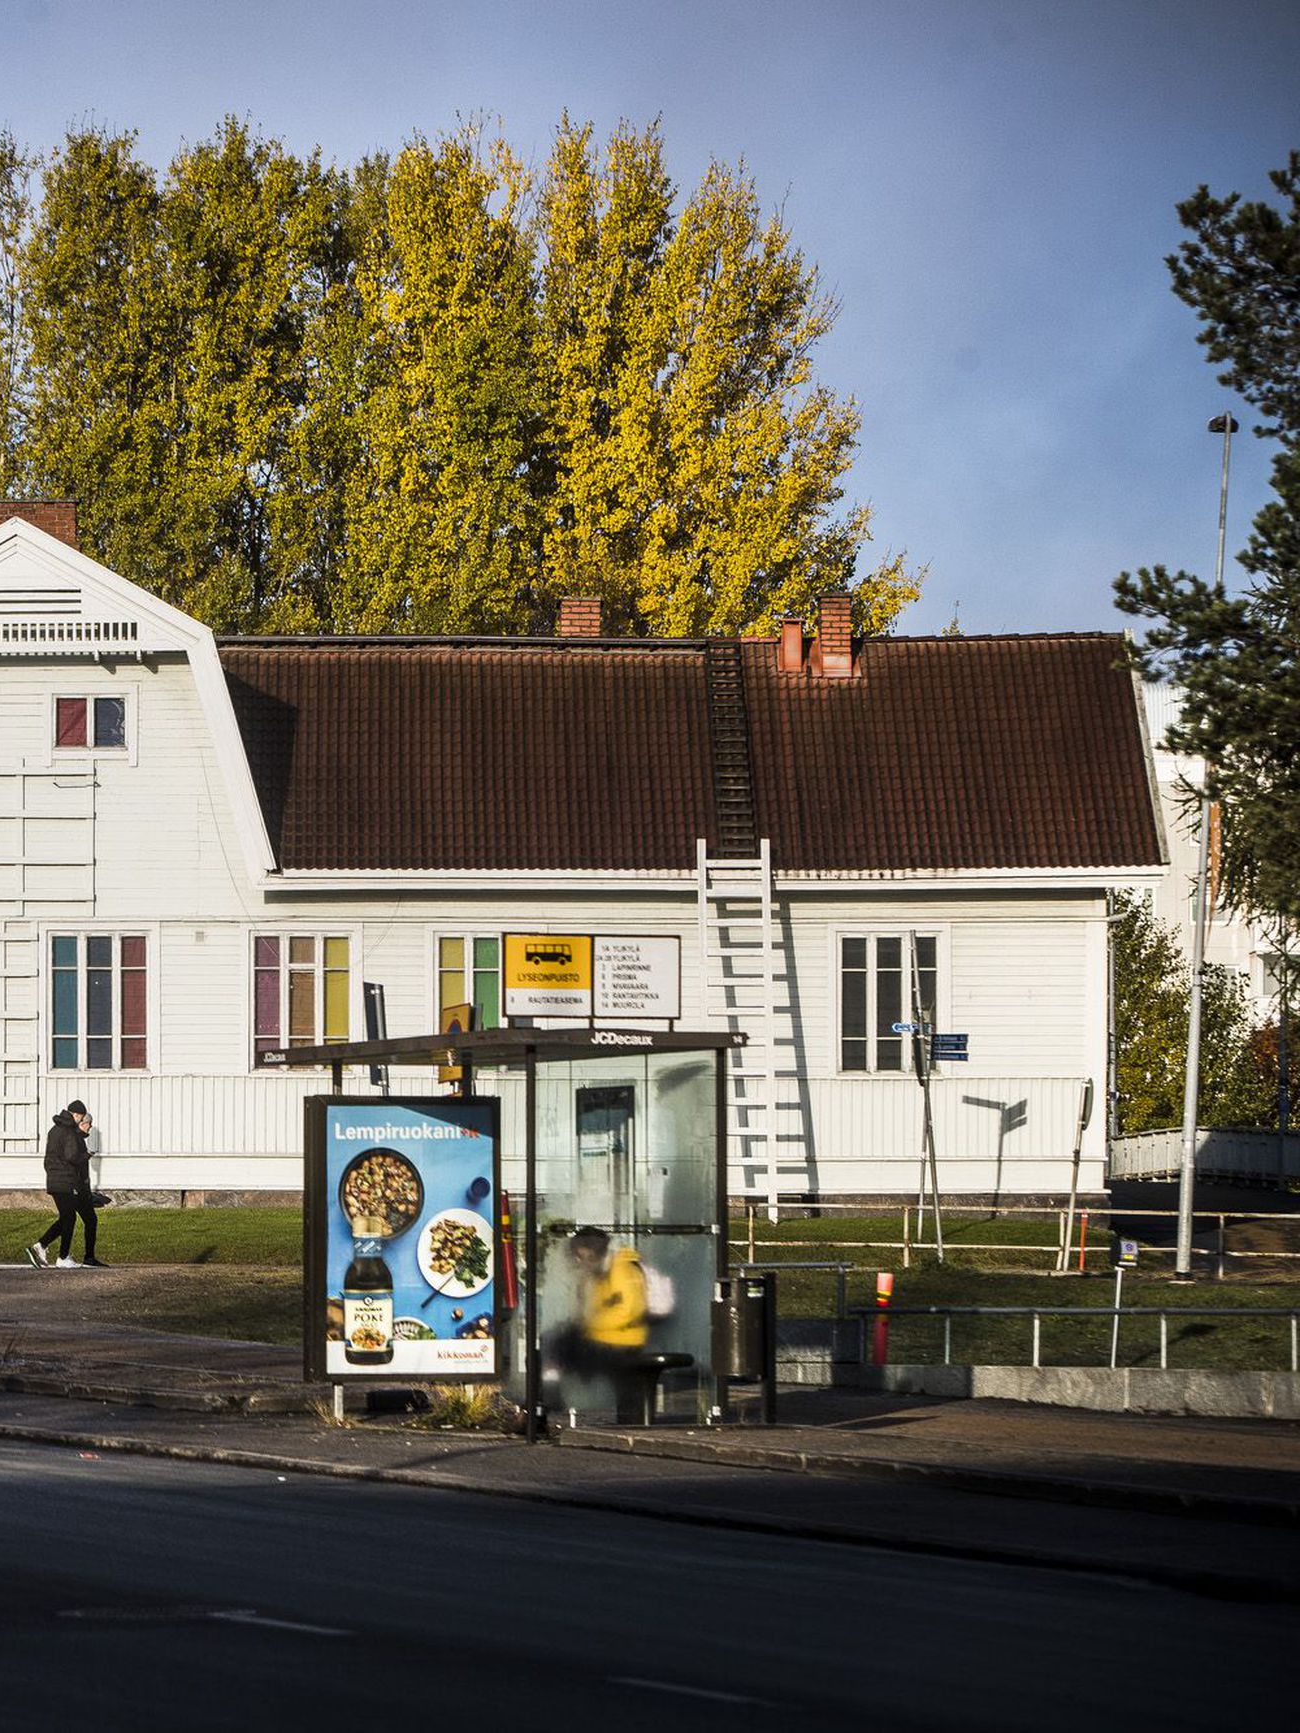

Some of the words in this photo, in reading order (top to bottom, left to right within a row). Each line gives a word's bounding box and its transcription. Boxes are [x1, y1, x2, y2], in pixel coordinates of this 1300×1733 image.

[516, 971, 580, 983] LYSEONPUISTO
[527, 995, 584, 1005] RAUTATIEASEMA
[591, 1031, 654, 1046] JCDecaux
